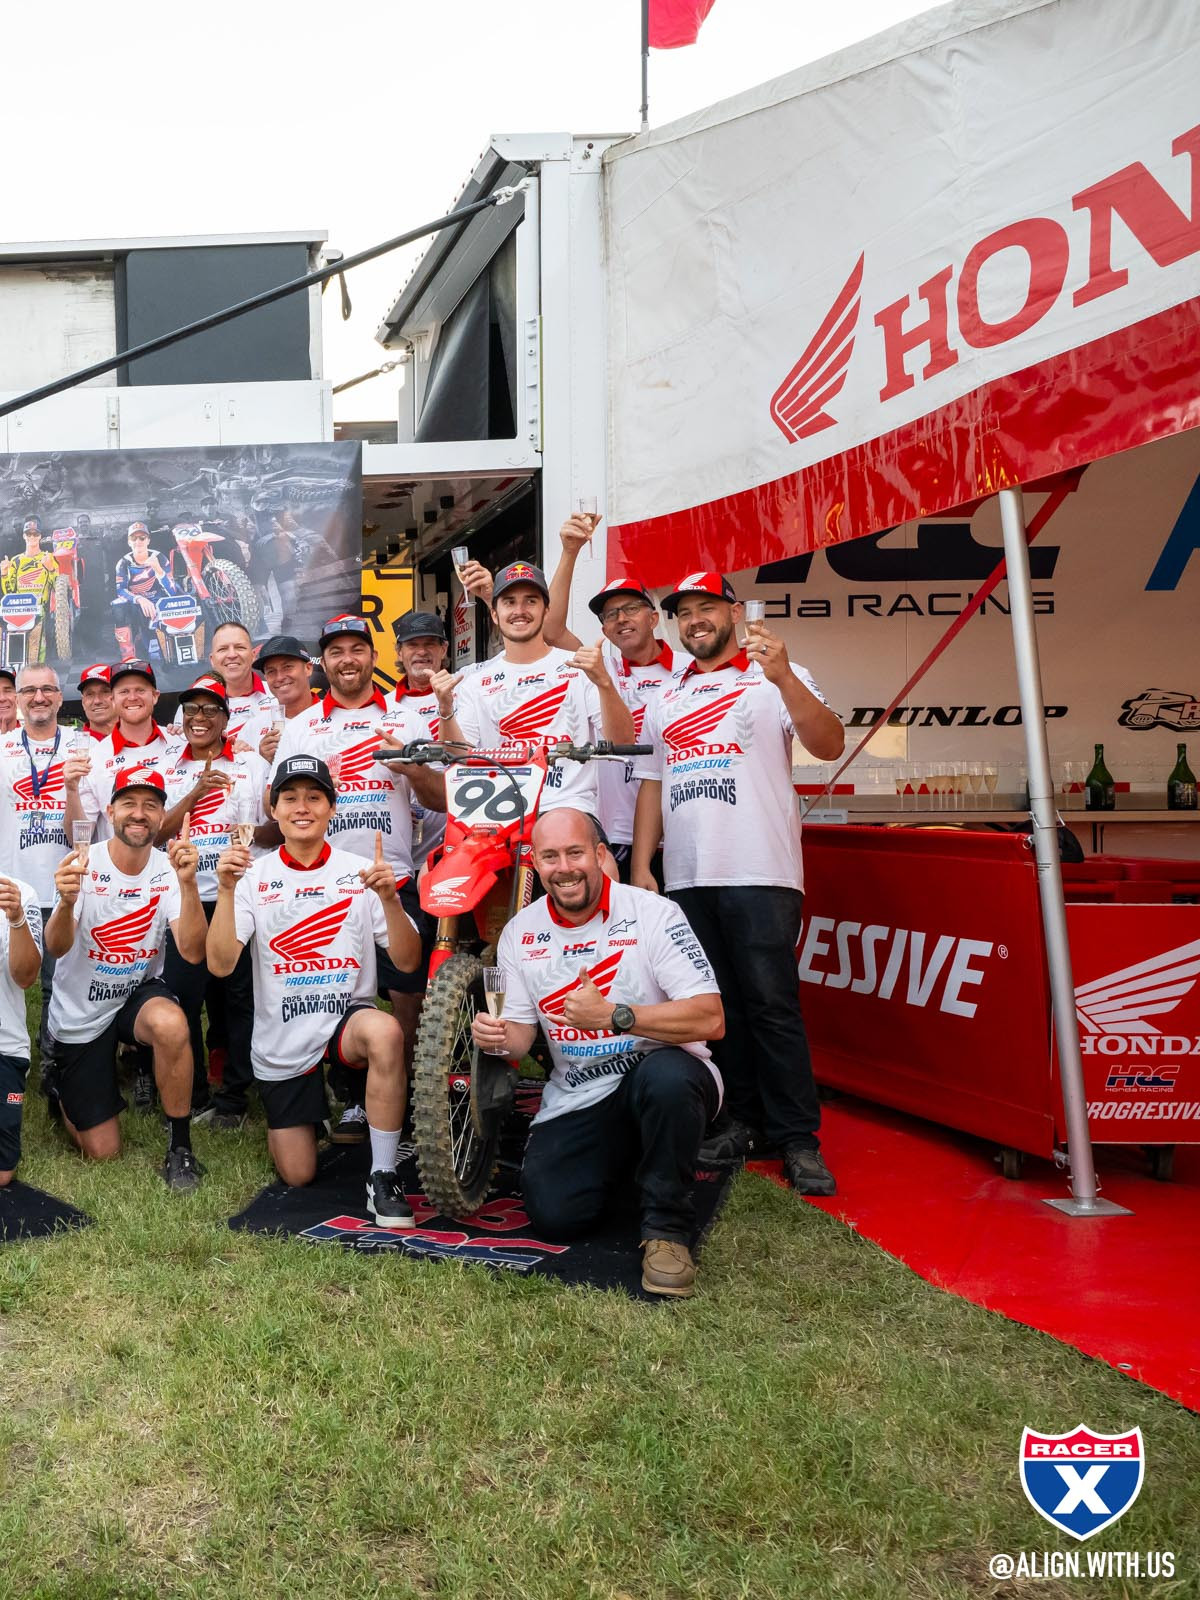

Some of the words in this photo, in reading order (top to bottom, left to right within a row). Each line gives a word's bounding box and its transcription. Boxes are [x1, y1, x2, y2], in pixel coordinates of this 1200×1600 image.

[494, 672, 505, 681] 96
[518, 673, 545, 685] HRC
[637, 680, 662, 690] HRC
[691, 683, 722, 695] HRC
[343, 721, 371, 730] HRC
[666, 742, 744, 765] HONDA
[115, 756, 125, 764] 96
[672, 758, 732, 774] PROGRESSIVE
[335, 780, 395, 792] ONDA
[670, 783, 682, 792] 2025
[684, 780, 696, 788] 450
[454, 779, 528, 821] 96
[670, 784, 737, 811] CHAMPIONS
[16, 801, 66, 811] HOND
[327, 817, 392, 837] CHAMPIONS
[205, 853, 220, 861] AMA
[99, 874, 111, 883] 96
[271, 880, 283, 889] 96
[295, 886, 325, 897] HRC
[429, 890, 467, 898] HONDA
[521, 935, 534, 945] 18
[537, 932, 551, 943] 96
[608, 939, 638, 947] SHOWA
[563, 941, 597, 955] HRC
[88, 948, 159, 964] HONDA
[95, 963, 149, 977] PROGRESSIVE
[273, 957, 361, 975] HONDA
[91, 979, 108, 988] 2025
[305, 994, 321, 1002] 450
[282, 1000, 351, 1023] CHAMPIONS
[561, 1040, 634, 1057] PROGRESSIVE
[1105, 1064, 1180, 1087] HRC
[454, 1081, 466, 1090] 96
